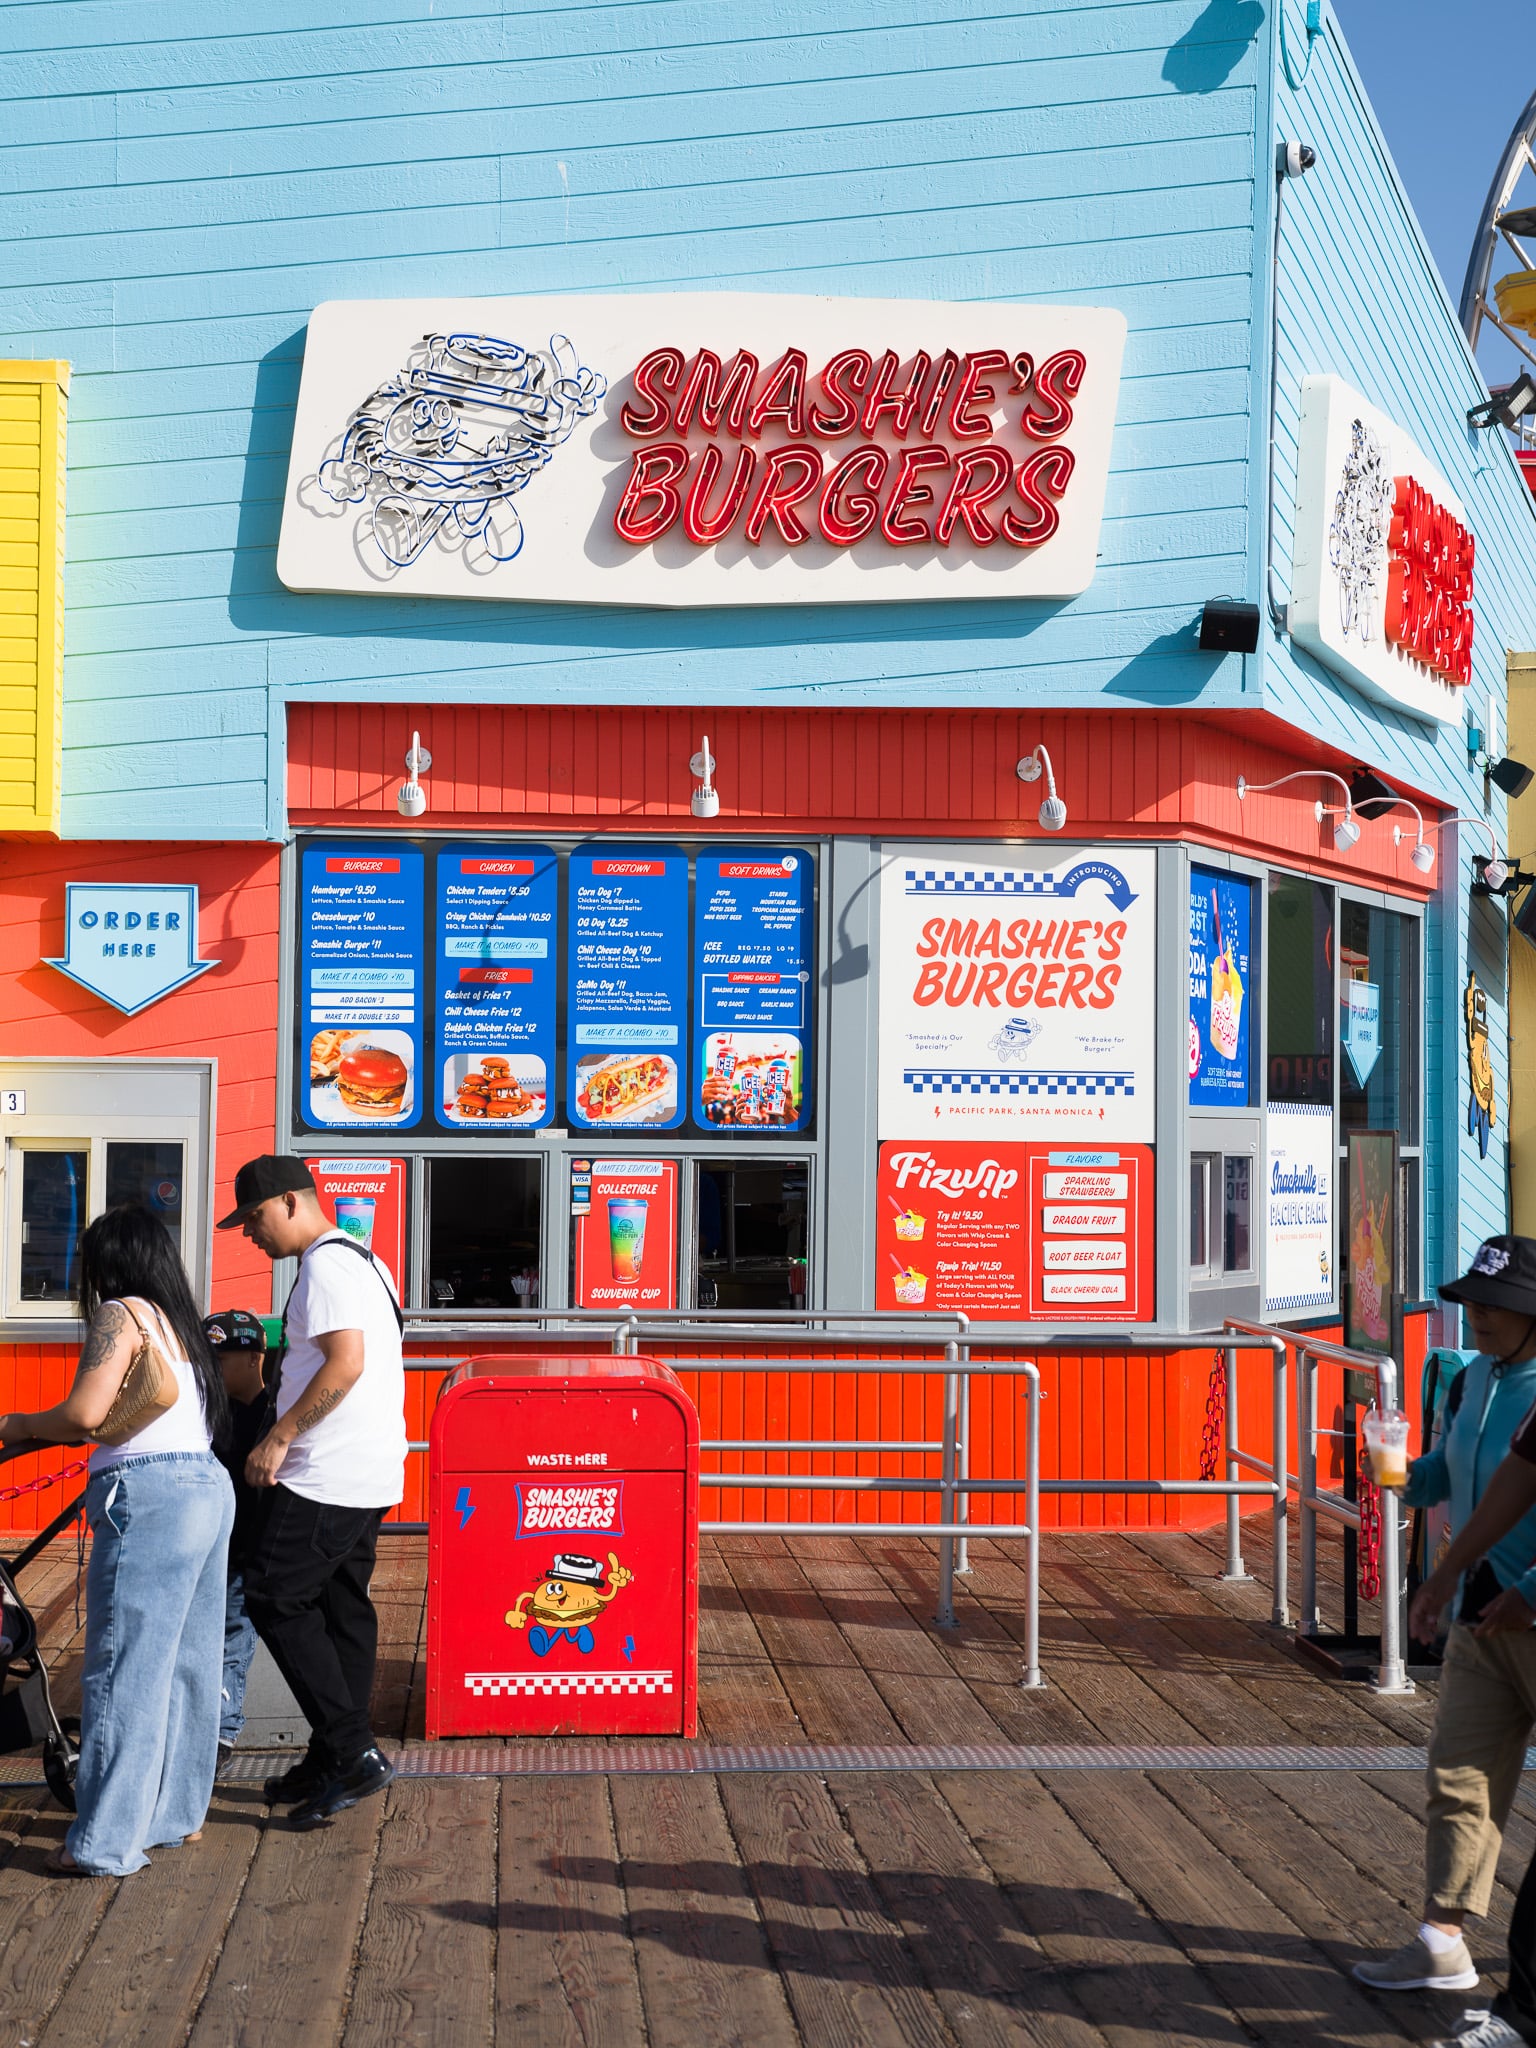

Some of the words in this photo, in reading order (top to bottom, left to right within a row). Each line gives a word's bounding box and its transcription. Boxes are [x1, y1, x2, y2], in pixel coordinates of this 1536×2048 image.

[621, 347, 1085, 442] SMASHIE'S
[613, 443, 1076, 548] BURGERS
[344, 862, 383, 871] BURGERS
[480, 863, 515, 871] CHICKEN
[607, 864, 651, 873] DOGTOWN
[729, 866, 751, 875] SOFT
[752, 867, 782, 876] DRINKS
[1067, 866, 1122, 887] INTRODUCING
[311, 885, 353, 896] Hamburger
[354, 885, 376, 895] $9.50
[447, 886, 475, 895] Chicken
[478, 886, 506, 895] Tenders
[508, 886, 530, 896] $8.50
[578, 887, 595, 896] Corn
[598, 887, 612, 898] Dog
[614, 887, 622, 896] $7
[79, 911, 181, 931] ORDER
[312, 912, 361, 923] Cheeseburger
[363, 912, 375, 921] $10
[446, 912, 467, 922] Crispy
[469, 912, 494, 920] Chicken
[496, 913, 527, 921] Sandwich
[529, 913, 551, 921] $10.50
[577, 918, 588, 927] OG
[591, 918, 605, 929] Dog
[608, 918, 629, 927] $8.25
[916, 918, 1127, 960] SMASHIE'S
[102, 943, 156, 958] HERE
[311, 940, 342, 949] Smashie
[344, 940, 370, 951] Burger
[371, 939, 381, 949] $11
[577, 945, 594, 954] Chili
[596, 945, 621, 955] Cheese
[623, 946, 637, 956] Dog
[640, 945, 651, 955] $10
[704, 942, 722, 951] ICEE
[703, 954, 740, 964] BOTTLED
[742, 955, 772, 964] WATER
[484, 972, 508, 981] FRIES
[576, 980, 598, 989] SaMo
[600, 980, 614, 991] Dog
[616, 980, 626, 989] $11
[912, 961, 1122, 1010] BURGERS
[445, 990, 470, 999] Basket
[473, 991, 480, 1000] of
[483, 991, 501, 1000] Fries
[503, 991, 511, 1000] $7
[445, 1007, 462, 1016] Chili
[464, 1007, 488, 1016] Cheese
[491, 1007, 509, 1016] Fries
[511, 1007, 522, 1016] $12
[444, 1022, 472, 1033] Buffalo
[475, 1023, 503, 1032] Chicken
[505, 1023, 523, 1033] Fries
[525, 1022, 536, 1032] $12
[1084, 1045, 1115, 1053] Burgers"
[8, 1093, 17, 1111] 3
[949, 1107, 985, 1115] PACIFIC
[988, 1107, 1017, 1116] PARK,
[1055, 1108, 1093, 1116] MONICA
[1066, 1155, 1102, 1164] FLAVORS
[323, 1163, 353, 1171] LIMITED
[355, 1163, 388, 1171] EDITION
[596, 1165, 625, 1173] LIMITED
[627, 1165, 660, 1173] EDITION
[889, 1152, 1018, 1199] Fizwip
[1065, 1176, 1110, 1186] SPARKLING
[1271, 1160, 1316, 1195] Snackville
[324, 1182, 386, 1193] COLLECTIBLE
[597, 1184, 658, 1195] COLLECTIBLE
[1059, 1187, 1115, 1196] STRAWBERRY
[937, 1211, 950, 1222] Try
[952, 1211, 961, 1220] It!
[962, 1211, 983, 1220] $9.50
[1271, 1203, 1303, 1226] PACIFIC
[1306, 1202, 1327, 1224] PARK
[1052, 1216, 1090, 1225] DRAGON
[1091, 1216, 1117, 1225] FRUIT
[1049, 1252, 1071, 1261] ROOT
[1073, 1252, 1094, 1261] BEER
[1096, 1252, 1122, 1261] FLOAT
[936, 1261, 959, 1272] Fizwip
[961, 1261, 978, 1272] Trip!
[980, 1261, 1002, 1271] $11.50
[591, 1288, 639, 1299] SOUVENIR
[641, 1288, 661, 1299] CUP
[1051, 1286, 1072, 1294] BLACK
[1074, 1286, 1100, 1294] CHERRY
[1102, 1285, 1118, 1293] COLA
[527, 1454, 572, 1466] WASTE
[575, 1453, 608, 1465] HERE
[525, 1487, 618, 1508] SMASHIE'S
[523, 1507, 615, 1529] BURGERS
